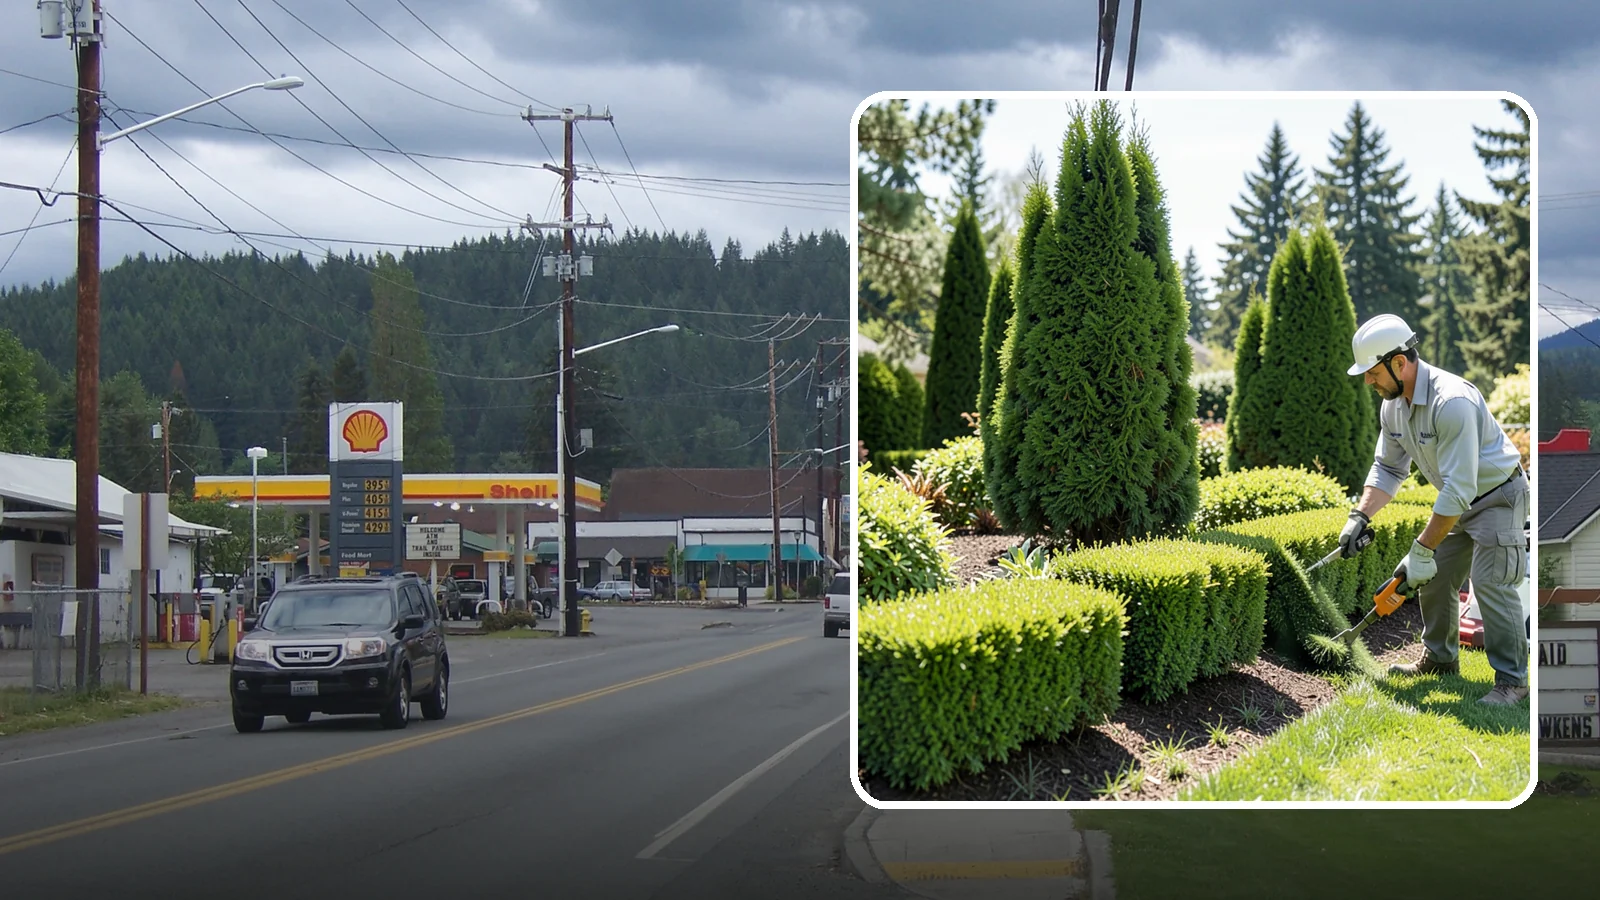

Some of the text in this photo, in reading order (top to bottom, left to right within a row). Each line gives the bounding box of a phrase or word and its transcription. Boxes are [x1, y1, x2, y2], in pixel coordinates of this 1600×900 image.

[366, 480, 383, 490] 395
[490, 484, 547, 498] Shell
[366, 494, 383, 504] 405
[366, 508, 383, 517] 415
[366, 522, 383, 532] 429
[1538, 642, 1566, 665] AID
